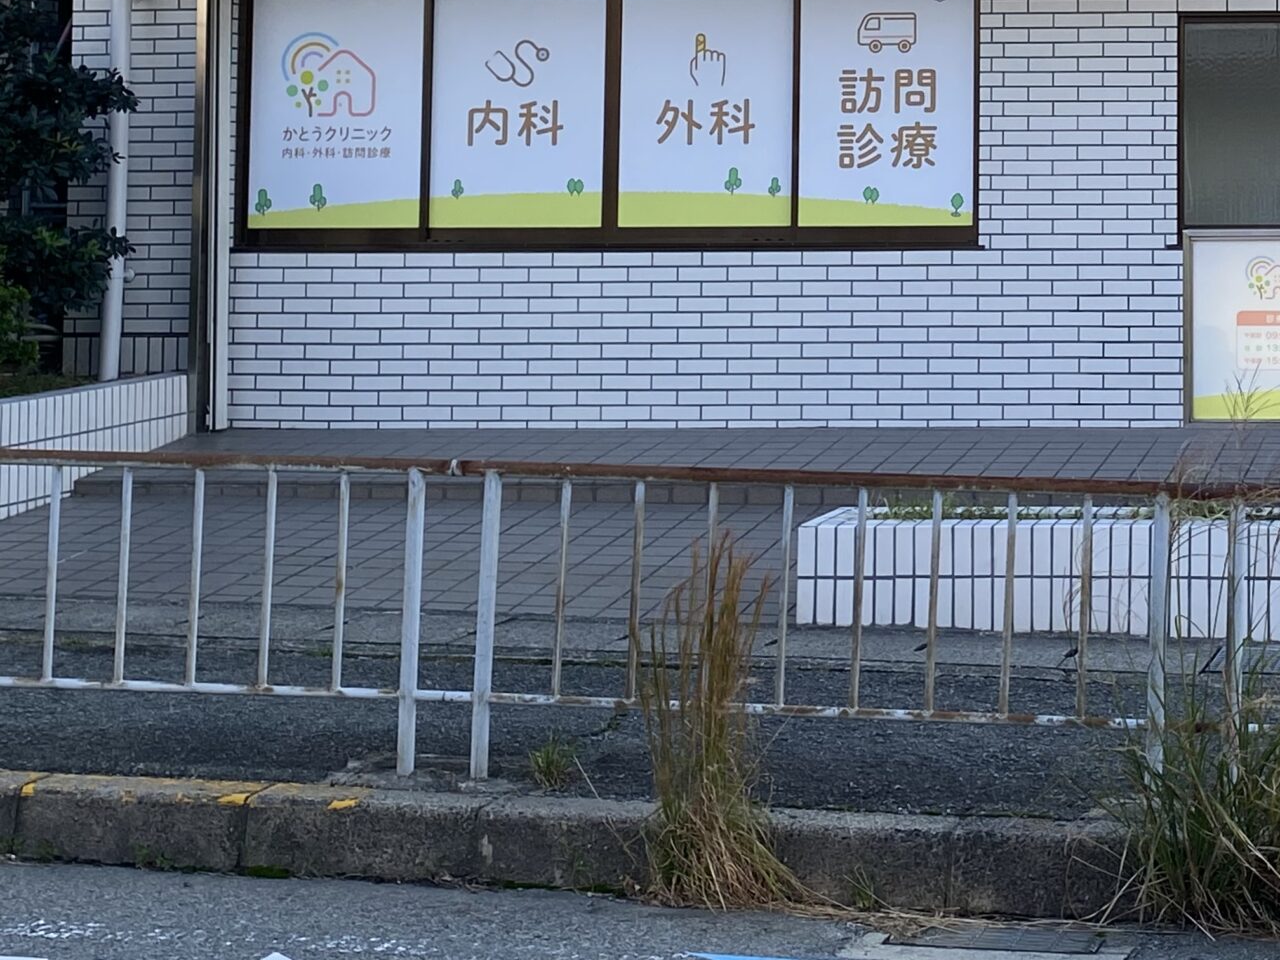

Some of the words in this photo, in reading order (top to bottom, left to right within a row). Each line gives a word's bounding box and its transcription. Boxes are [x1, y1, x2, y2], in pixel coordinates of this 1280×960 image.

[839, 68, 937, 115] 訪問
[282, 125, 392, 142] かとうクリニック
[467, 99, 564, 148] 内科
[656, 98, 756, 147] 外科
[836, 121, 938, 171] 診療
[281, 147, 391, 159] 内科・外科・訪問診療
